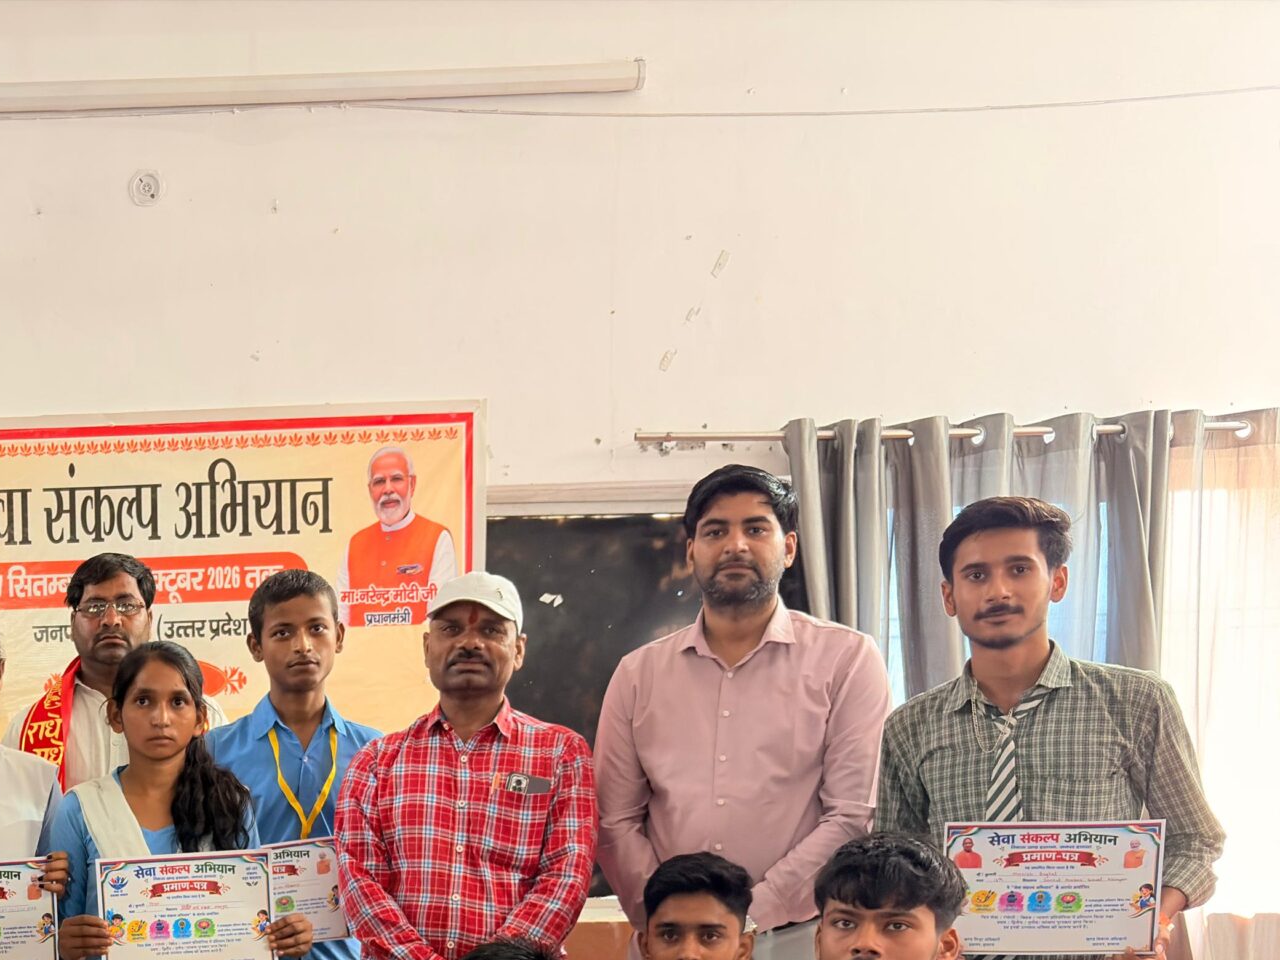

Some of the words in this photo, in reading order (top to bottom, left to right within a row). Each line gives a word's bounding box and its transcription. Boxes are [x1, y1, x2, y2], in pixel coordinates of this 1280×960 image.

[43, 462, 162, 543] संकल्प
[174, 458, 333, 539] अभियान
[7, 565, 72, 598] सितम्ब
[152, 568, 205, 603] क्टूबर
[207, 565, 240, 590] 2026
[392, 583, 419, 601] मोदी
[421, 583, 438, 600] जी
[366, 608, 411, 625] प्रधानमंत्री
[32, 624, 72, 643] जनप
[28, 712, 63, 744] राधे
[988, 832, 1016, 846] सेवा
[1020, 832, 1060, 844] संकल्प
[1064, 831, 1118, 846] अभियान
[273, 849, 310, 860] अभियान
[1022, 851, 1080, 862] प्रमाण-पत्र
[133, 865, 156, 879] सेवा
[159, 864, 191, 875] संकल्प
[193, 861, 236, 875] अभियान
[162, 880, 208, 893] प्रमाण-पत्र
